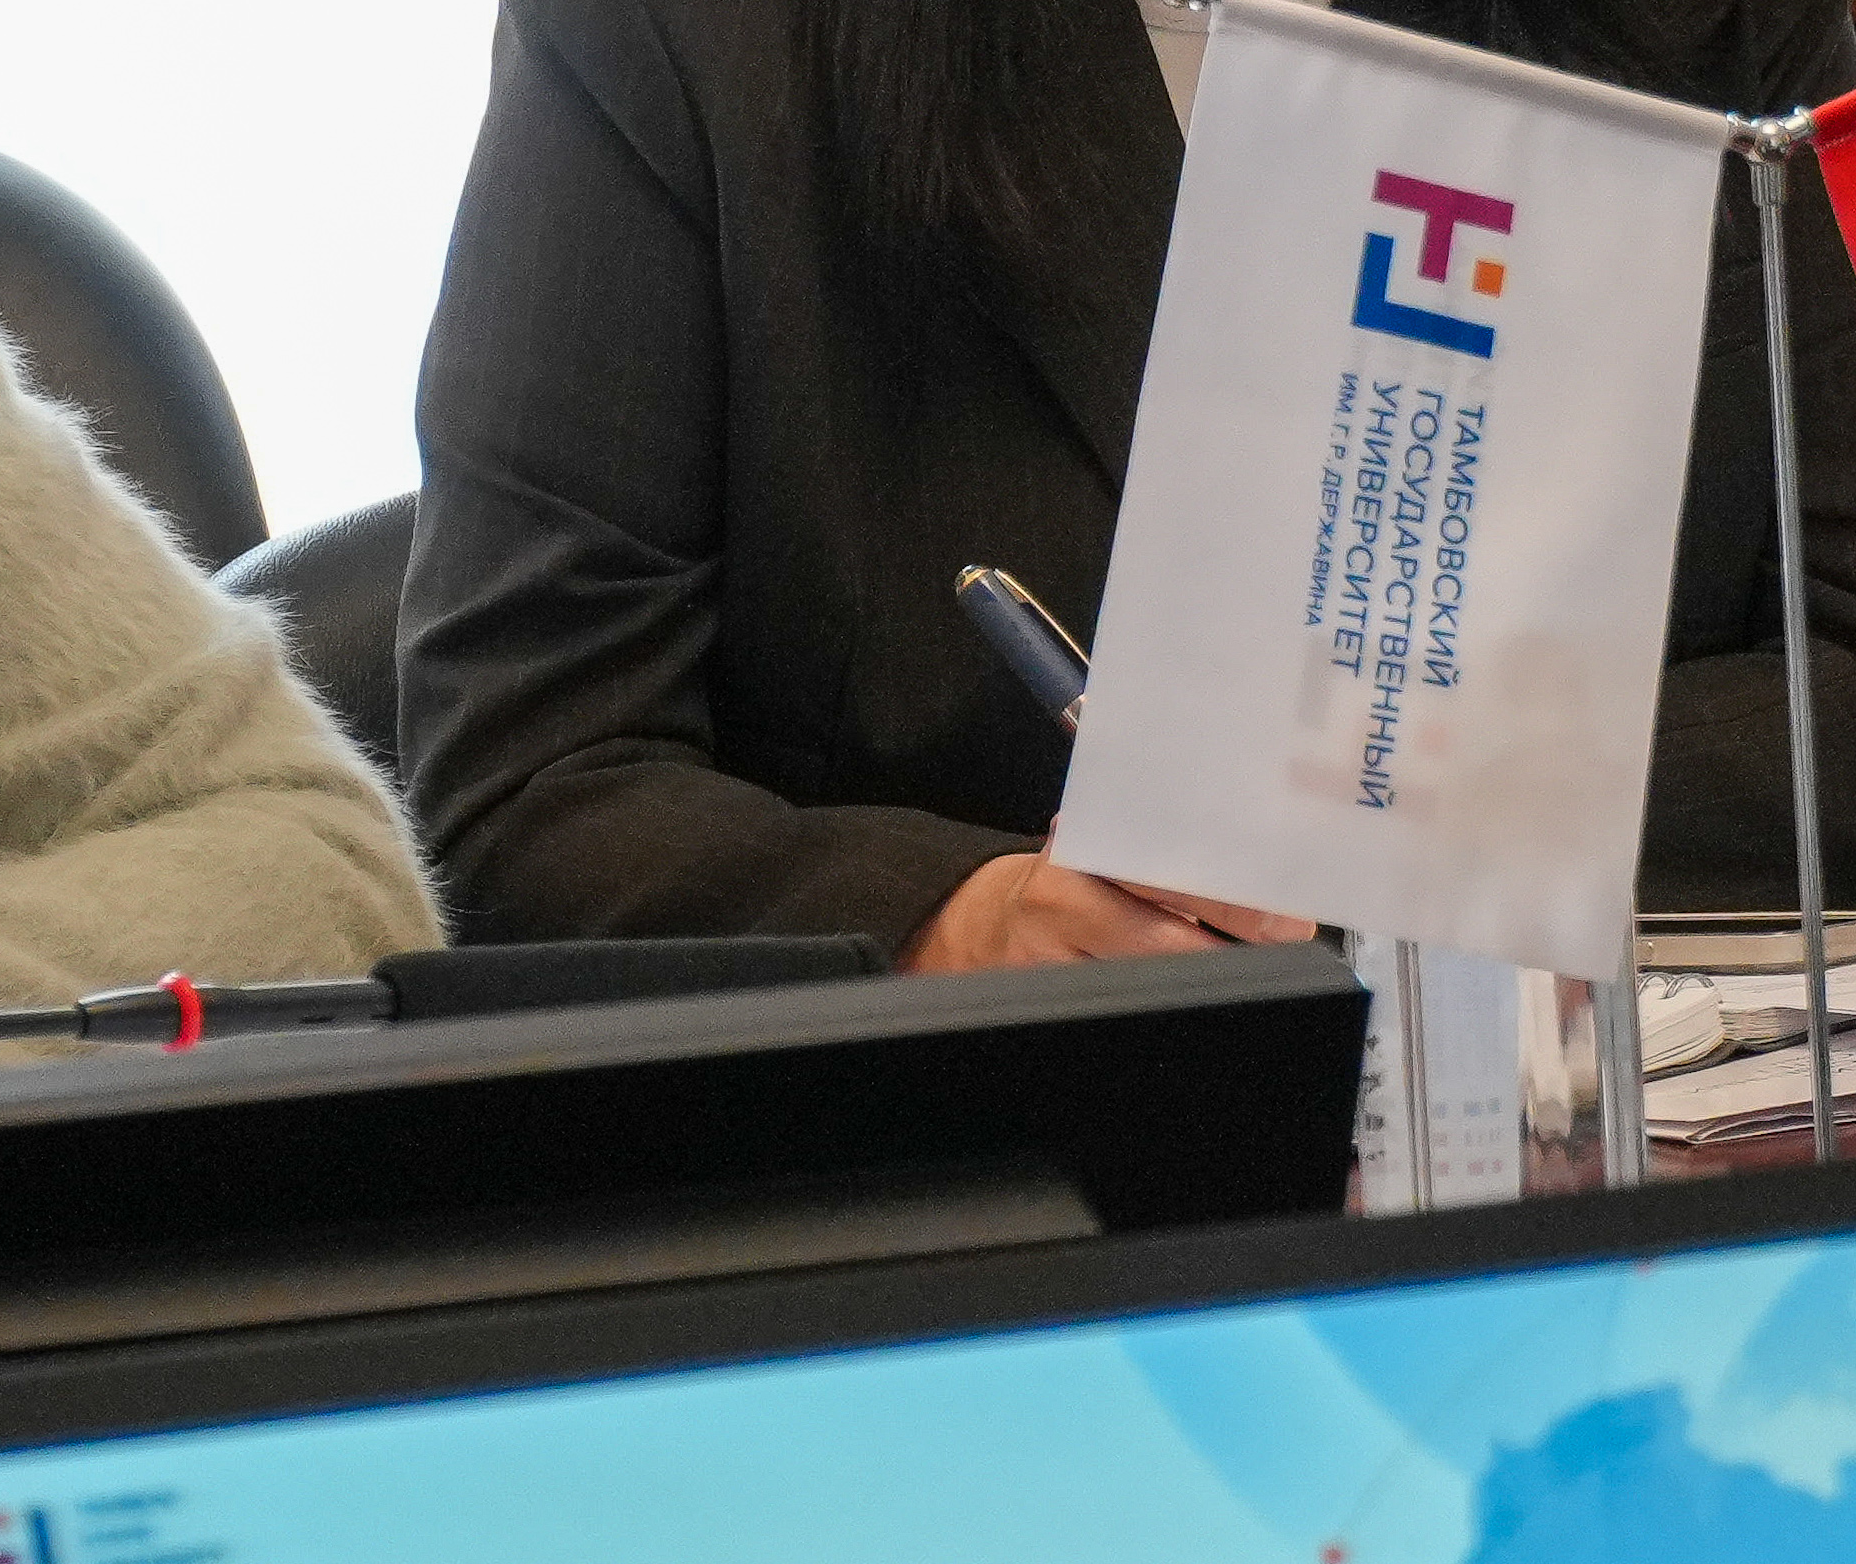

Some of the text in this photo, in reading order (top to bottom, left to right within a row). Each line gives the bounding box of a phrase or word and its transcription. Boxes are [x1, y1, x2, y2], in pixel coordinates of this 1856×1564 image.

[1304, 465, 1343, 627] ДЕРЖАВИНА
[1330, 380, 1402, 679] УНИВЕРСИТЕТ
[1356, 388, 1445, 809] ГОСУДАРСТВЕННЫЙ
[1422, 403, 1487, 688] ТАМБОВСКИЙ
